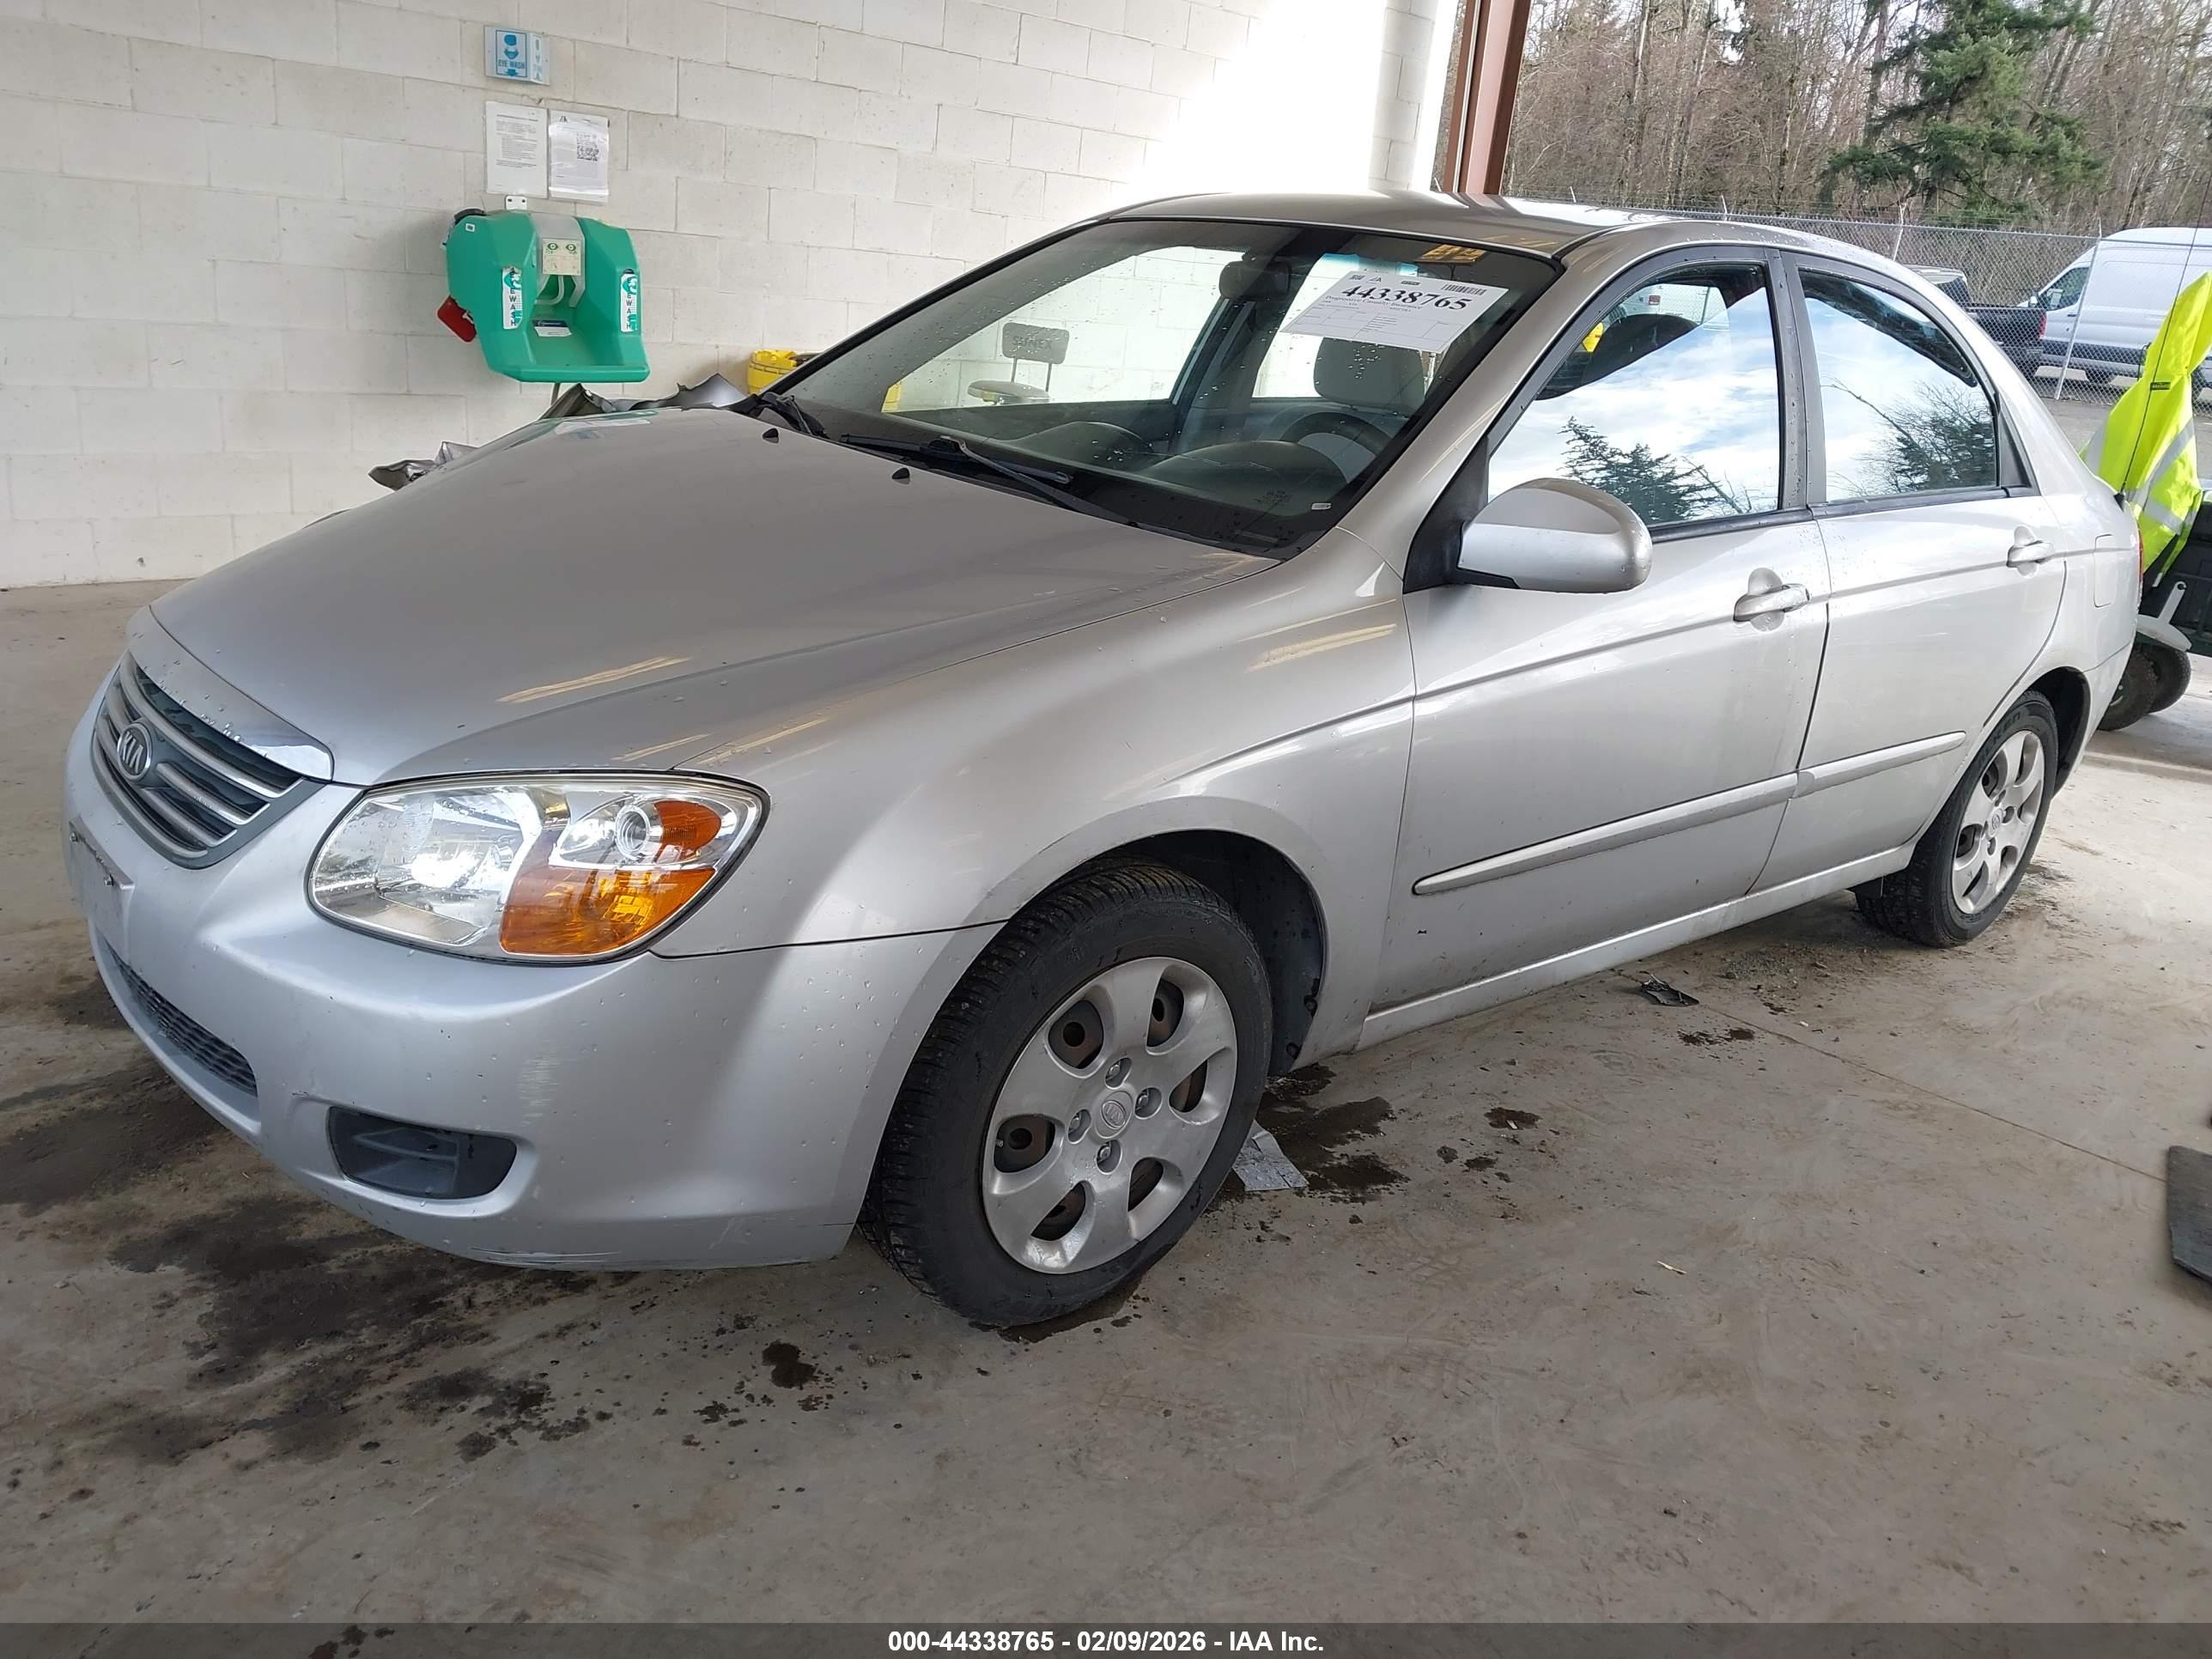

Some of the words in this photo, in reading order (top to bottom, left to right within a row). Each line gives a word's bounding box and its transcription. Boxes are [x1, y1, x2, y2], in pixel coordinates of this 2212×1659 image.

[498, 59, 507, 68] EYE
[509, 61, 526, 70] WASH
[1341, 285, 1473, 310] 44338765
[122, 730, 144, 774] KIA
